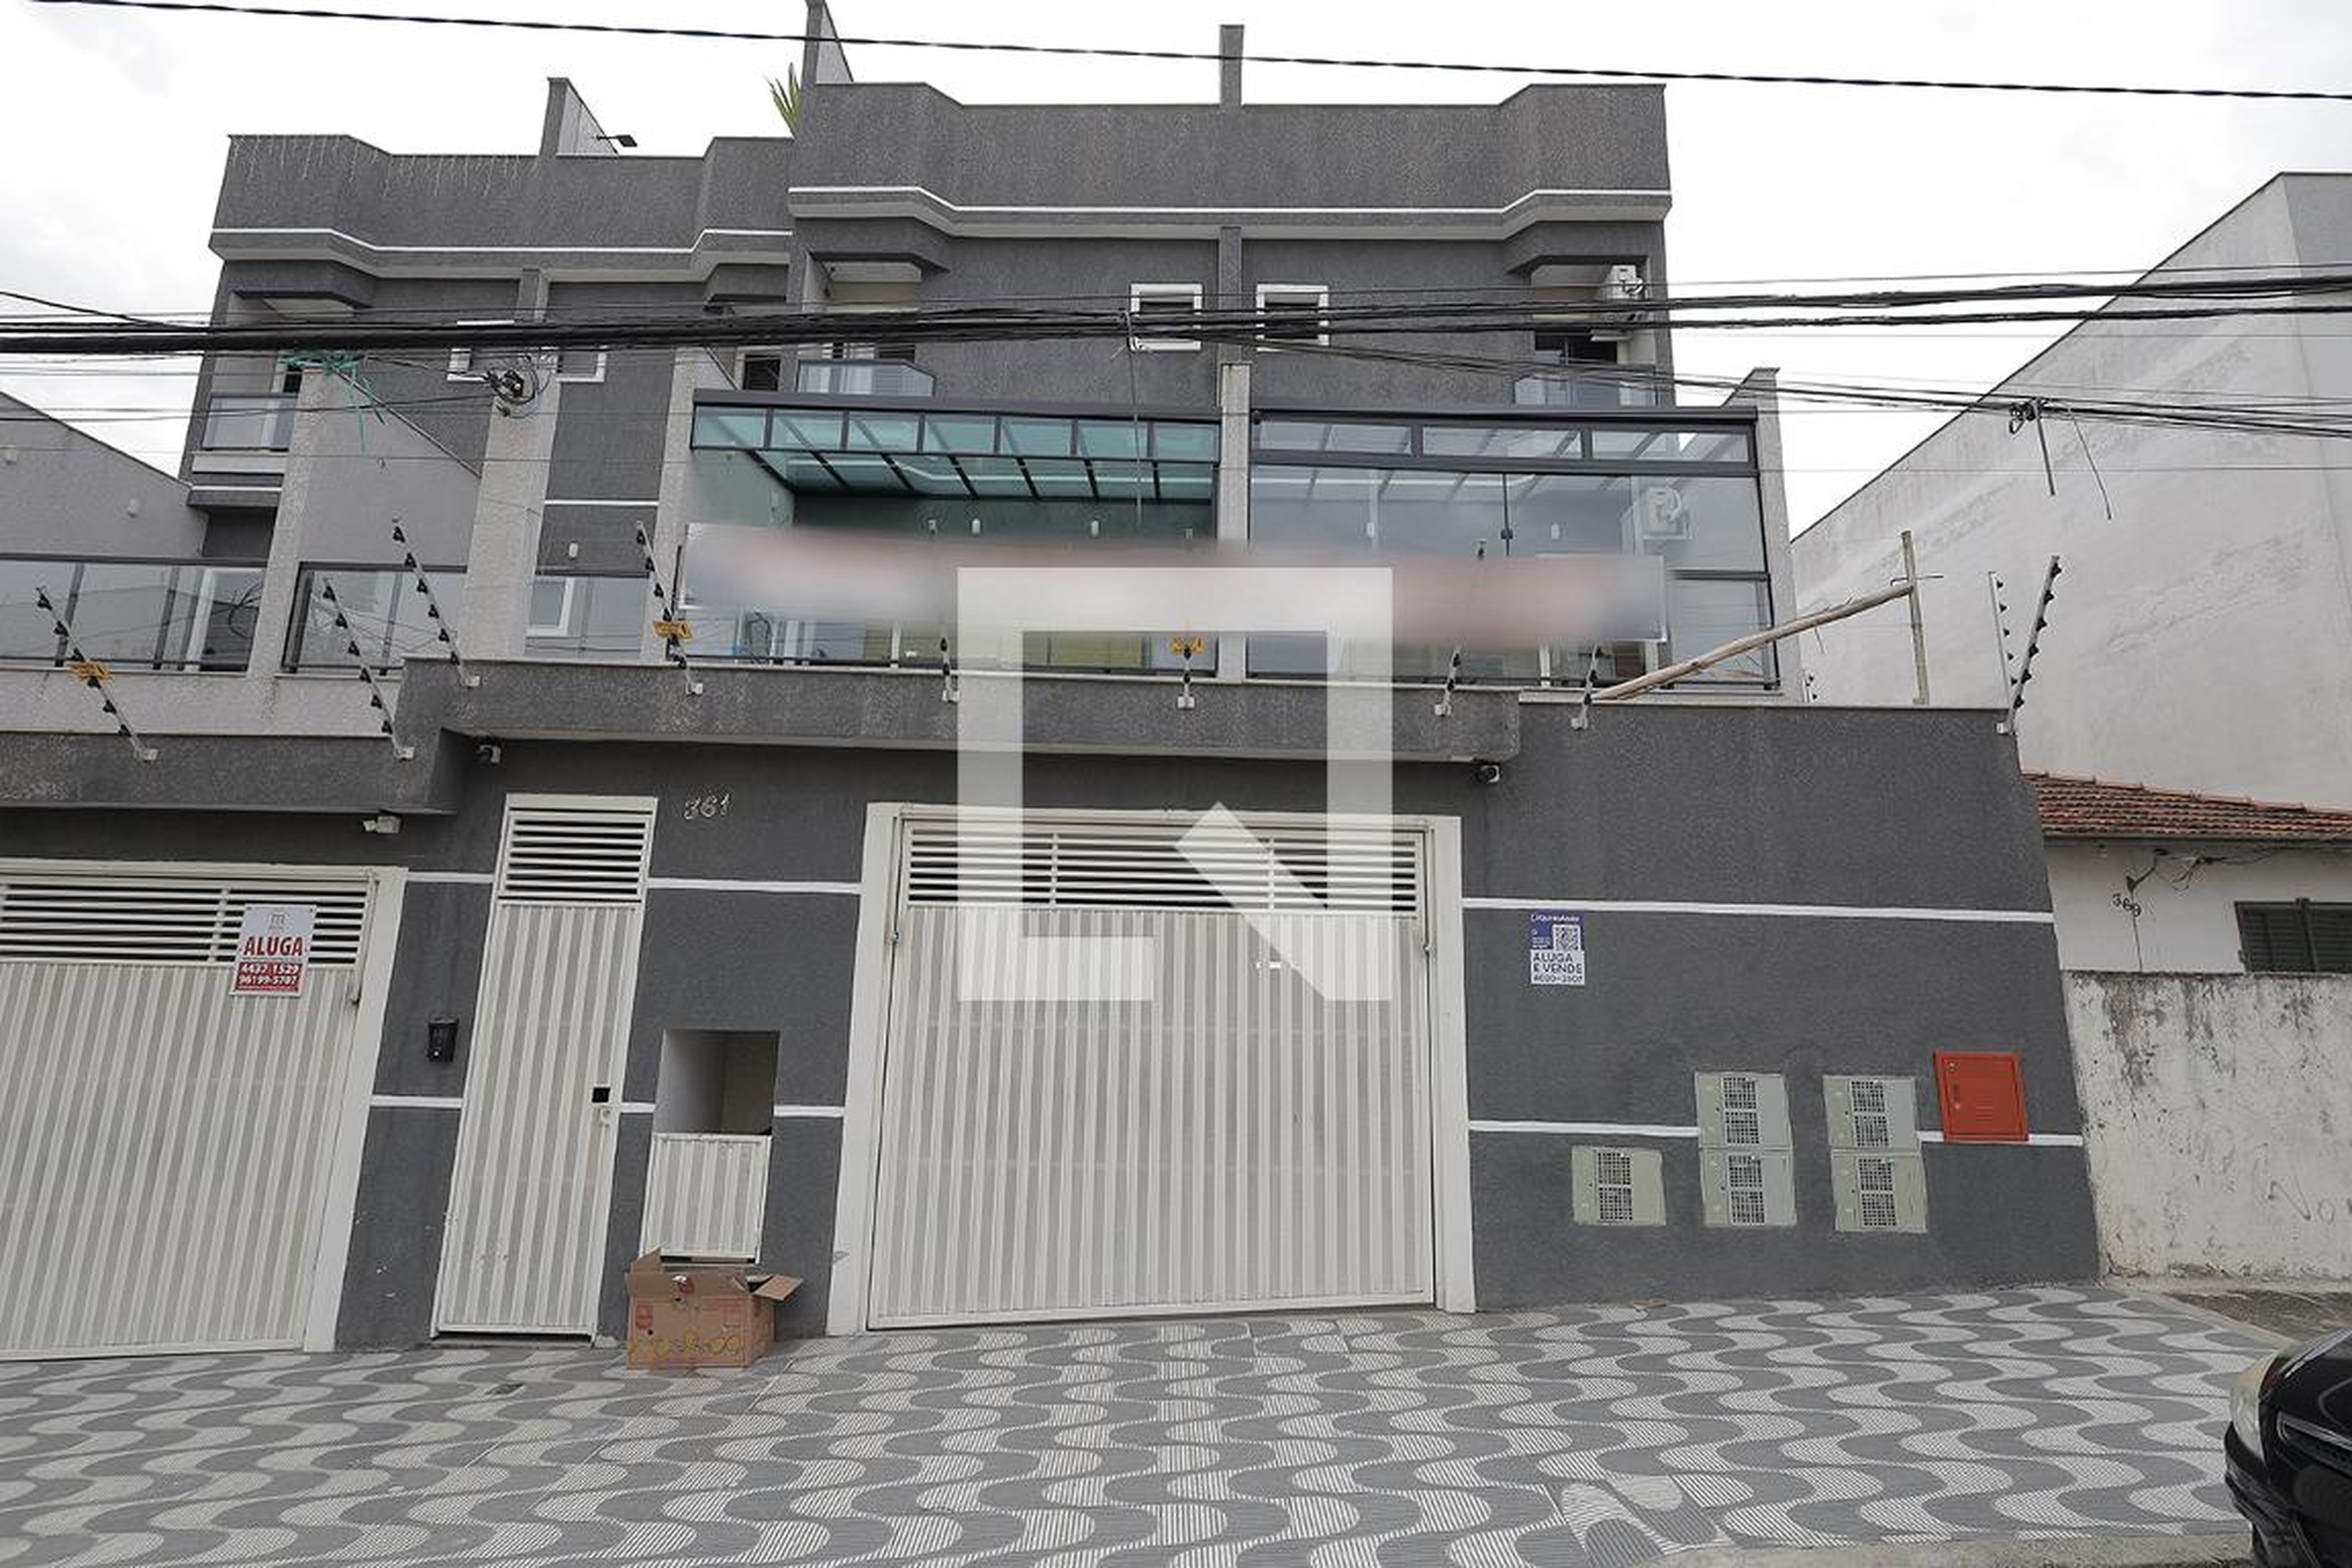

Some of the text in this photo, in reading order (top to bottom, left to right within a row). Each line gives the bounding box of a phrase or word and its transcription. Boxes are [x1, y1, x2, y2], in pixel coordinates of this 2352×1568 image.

[2113, 894, 2141, 918] 369
[244, 937, 303, 956] ALUGA
[1533, 953, 1573, 962] ALUGA
[1533, 963, 1582, 974] E VENDE
